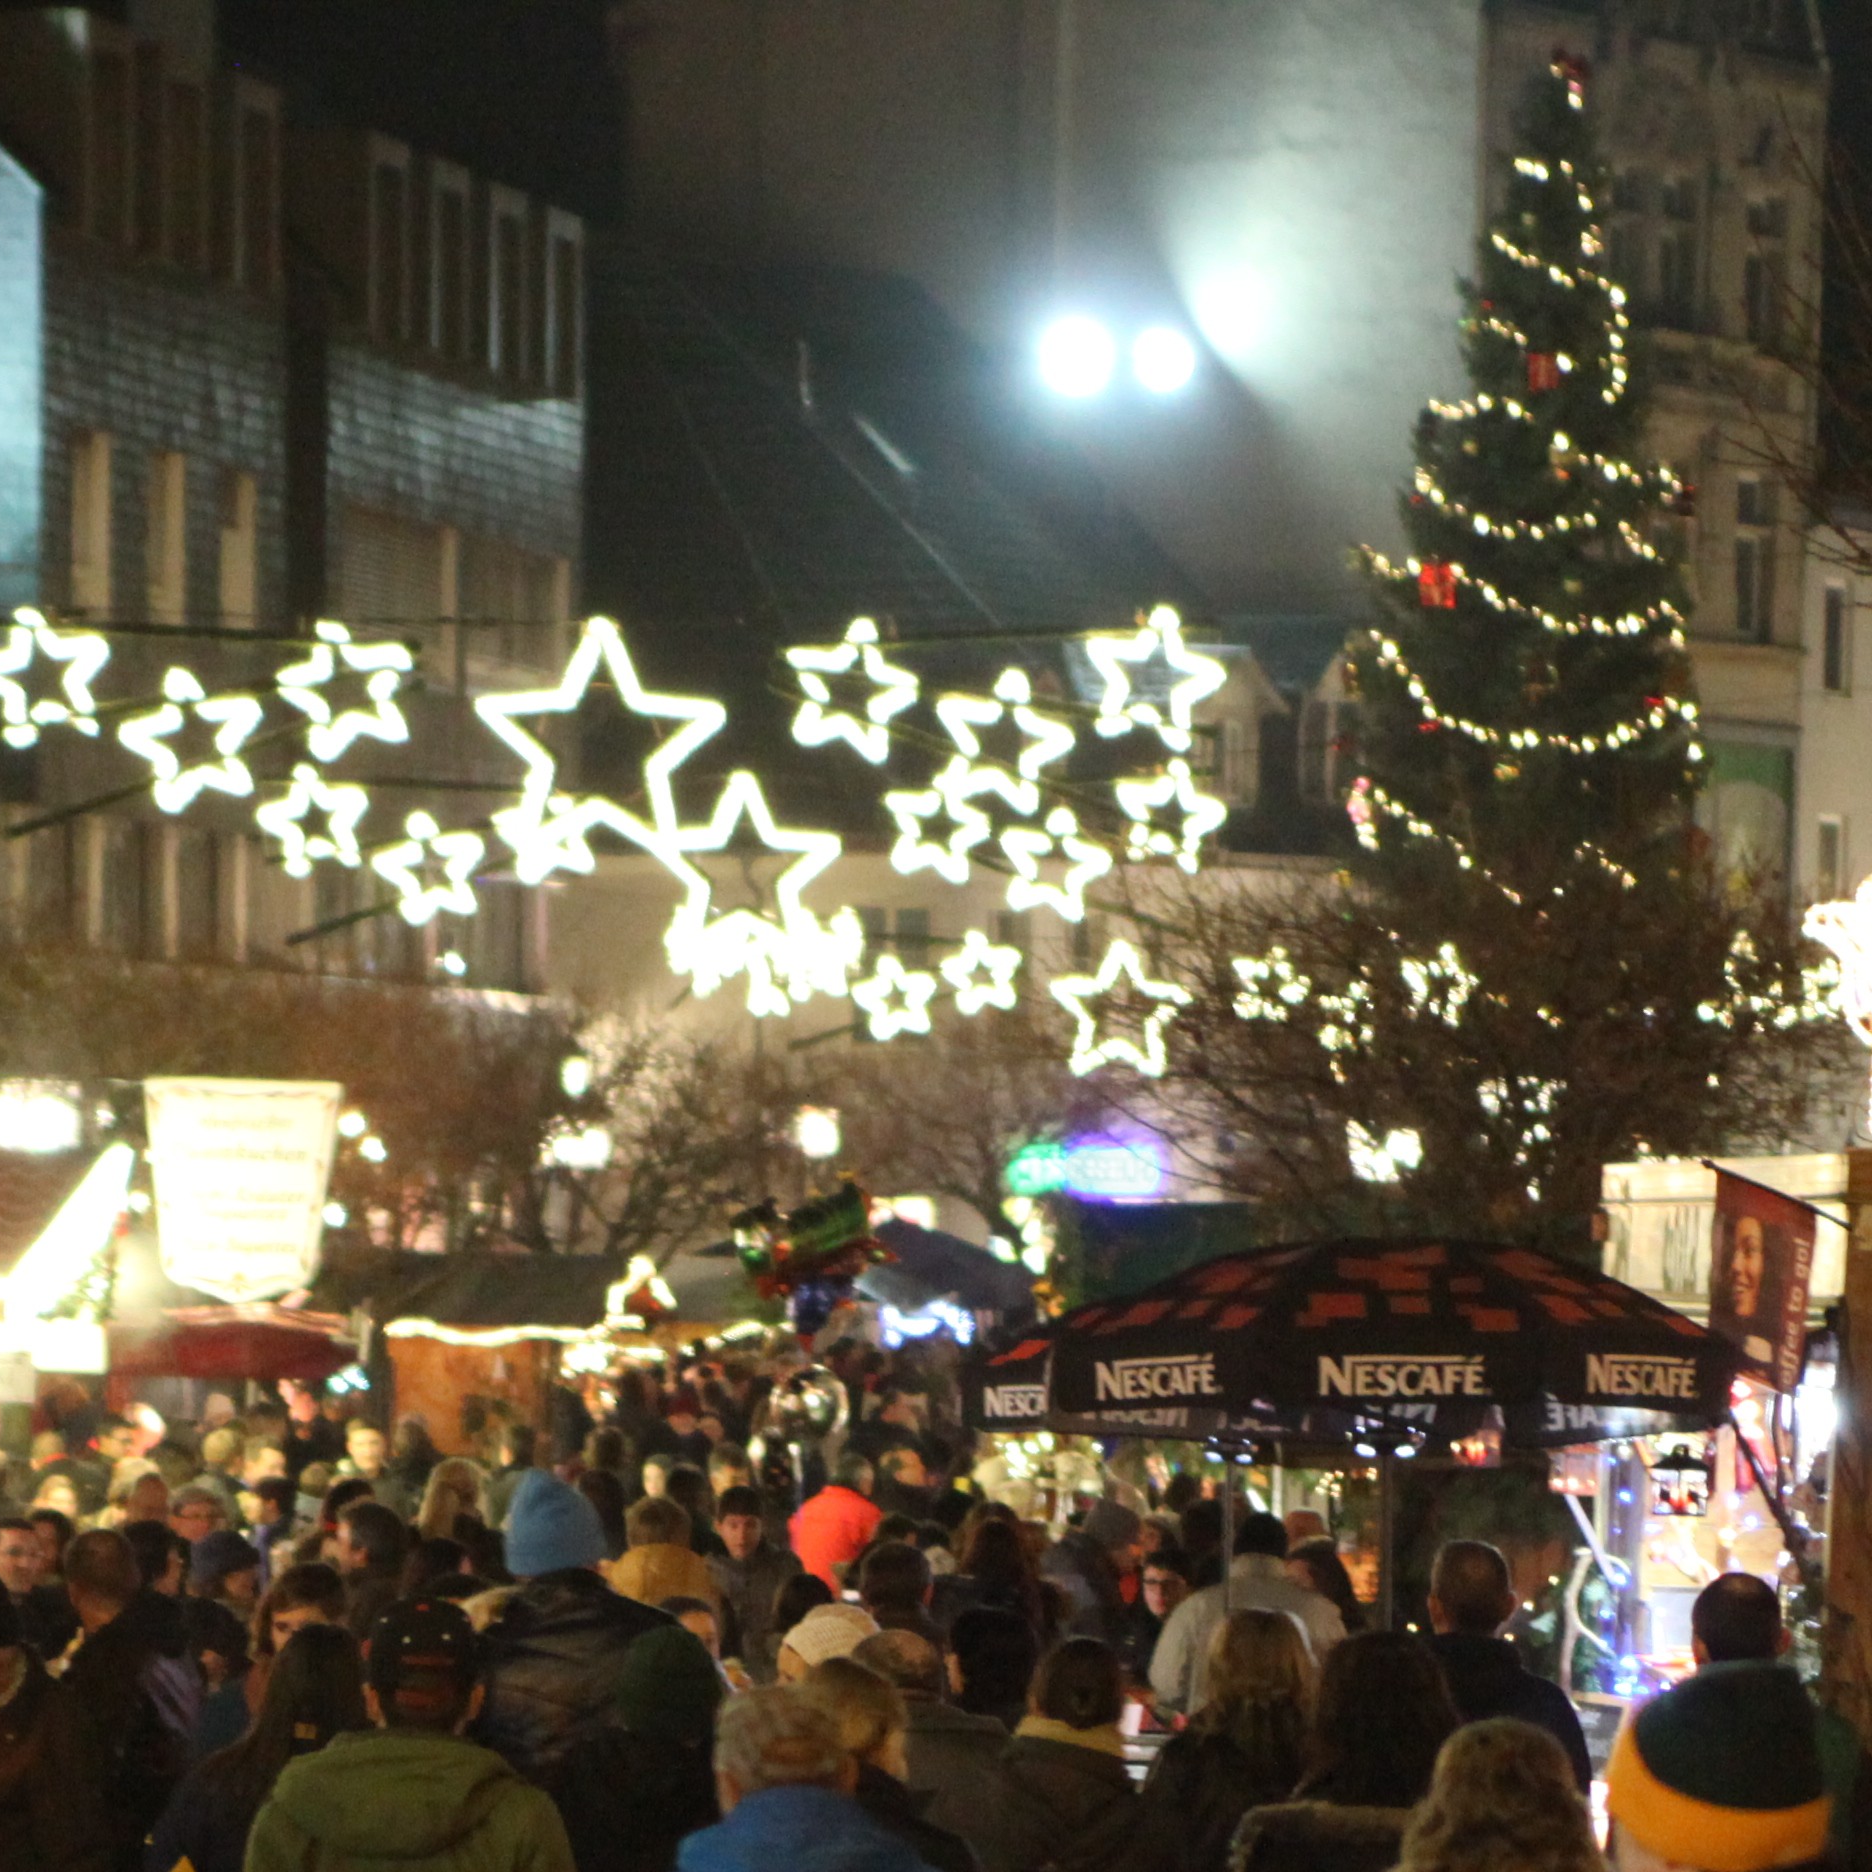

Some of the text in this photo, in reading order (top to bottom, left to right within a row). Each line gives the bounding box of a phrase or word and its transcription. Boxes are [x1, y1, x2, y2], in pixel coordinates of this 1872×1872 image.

[1787, 1285, 1805, 1313] to
[1317, 1353, 1488, 1397] NESCAFÉ
[1585, 1352, 1698, 1398] NESCAFÉ
[1778, 1321, 1800, 1386] offee
[1094, 1352, 1217, 1402] NESCAFÉ
